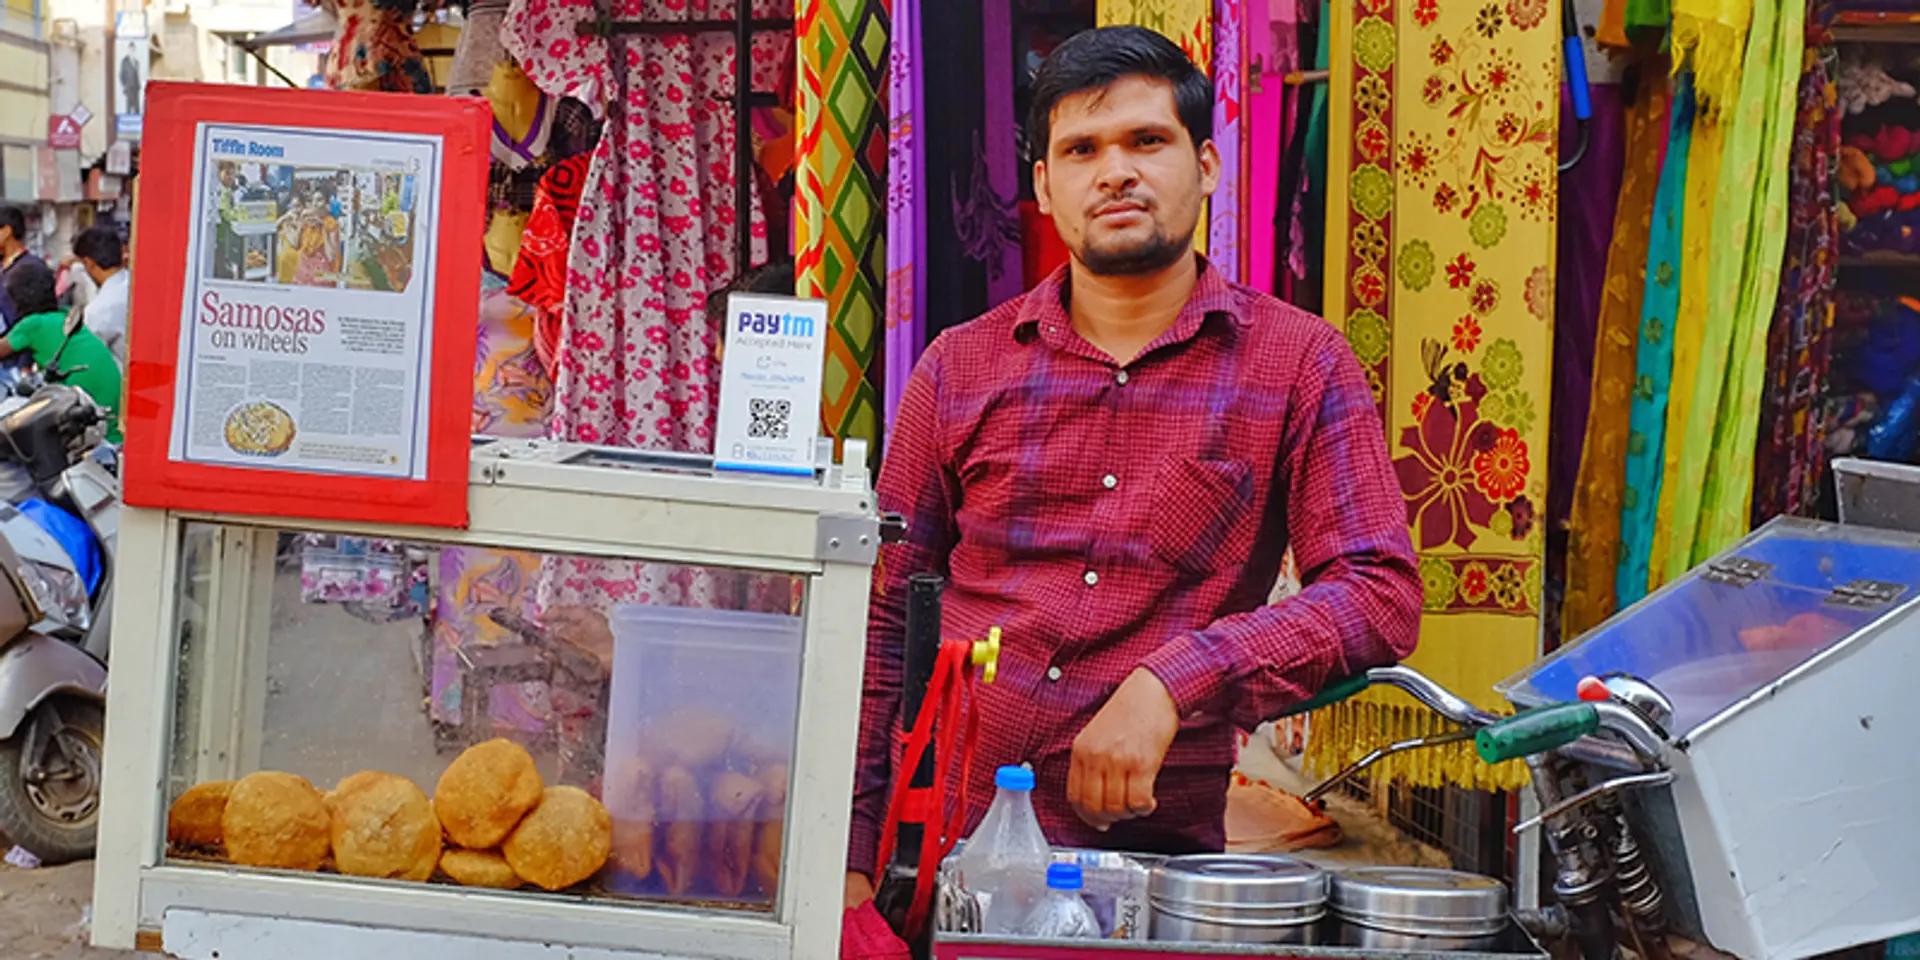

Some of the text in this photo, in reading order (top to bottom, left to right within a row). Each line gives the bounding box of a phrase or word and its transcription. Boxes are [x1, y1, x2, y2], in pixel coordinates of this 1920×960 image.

[212, 138, 285, 157] Tiffin Room
[200, 290, 326, 334] Samosas
[210, 329, 237, 349] on
[240, 327, 309, 355] wheels
